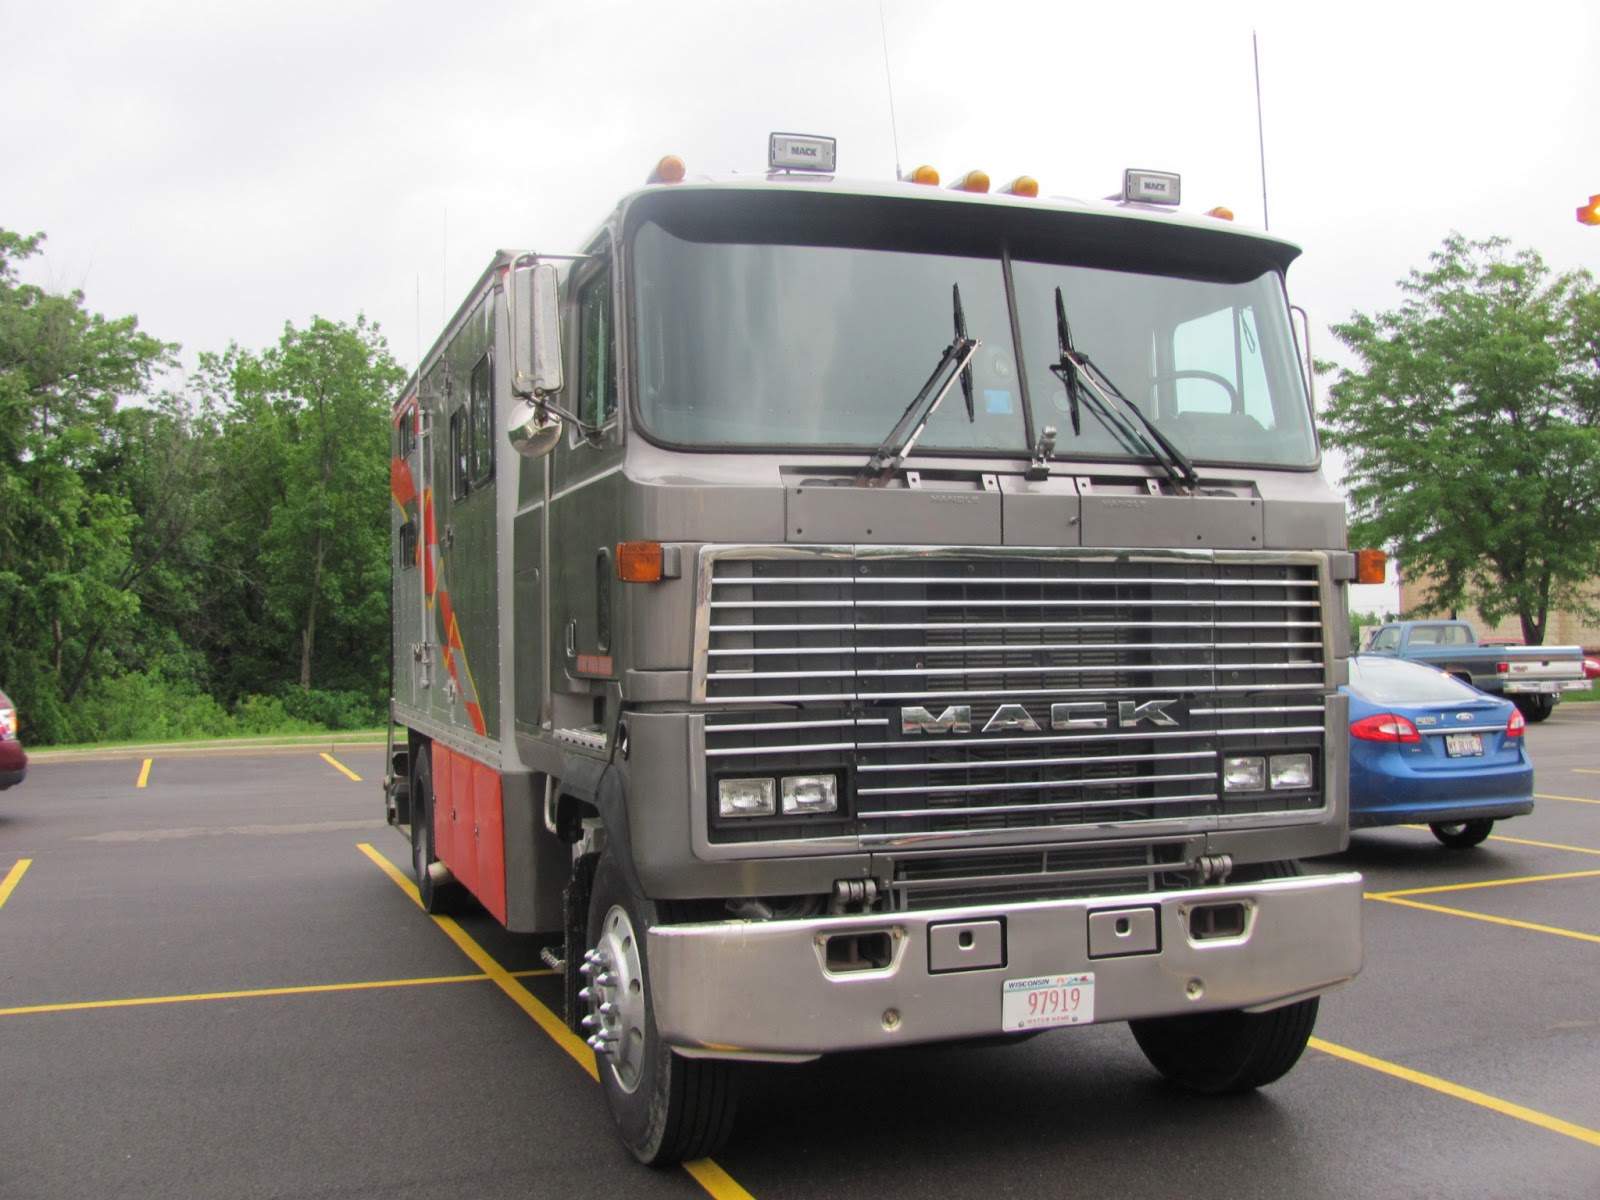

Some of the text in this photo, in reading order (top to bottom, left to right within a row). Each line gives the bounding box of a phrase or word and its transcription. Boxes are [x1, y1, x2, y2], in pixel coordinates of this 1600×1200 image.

[791, 146, 817, 156] MACK
[1144, 182, 1166, 191] MACK
[901, 699, 1180, 734] MACK
[1009, 979, 1050, 989] WISCONSIN
[1028, 987, 1081, 1015] 97919
